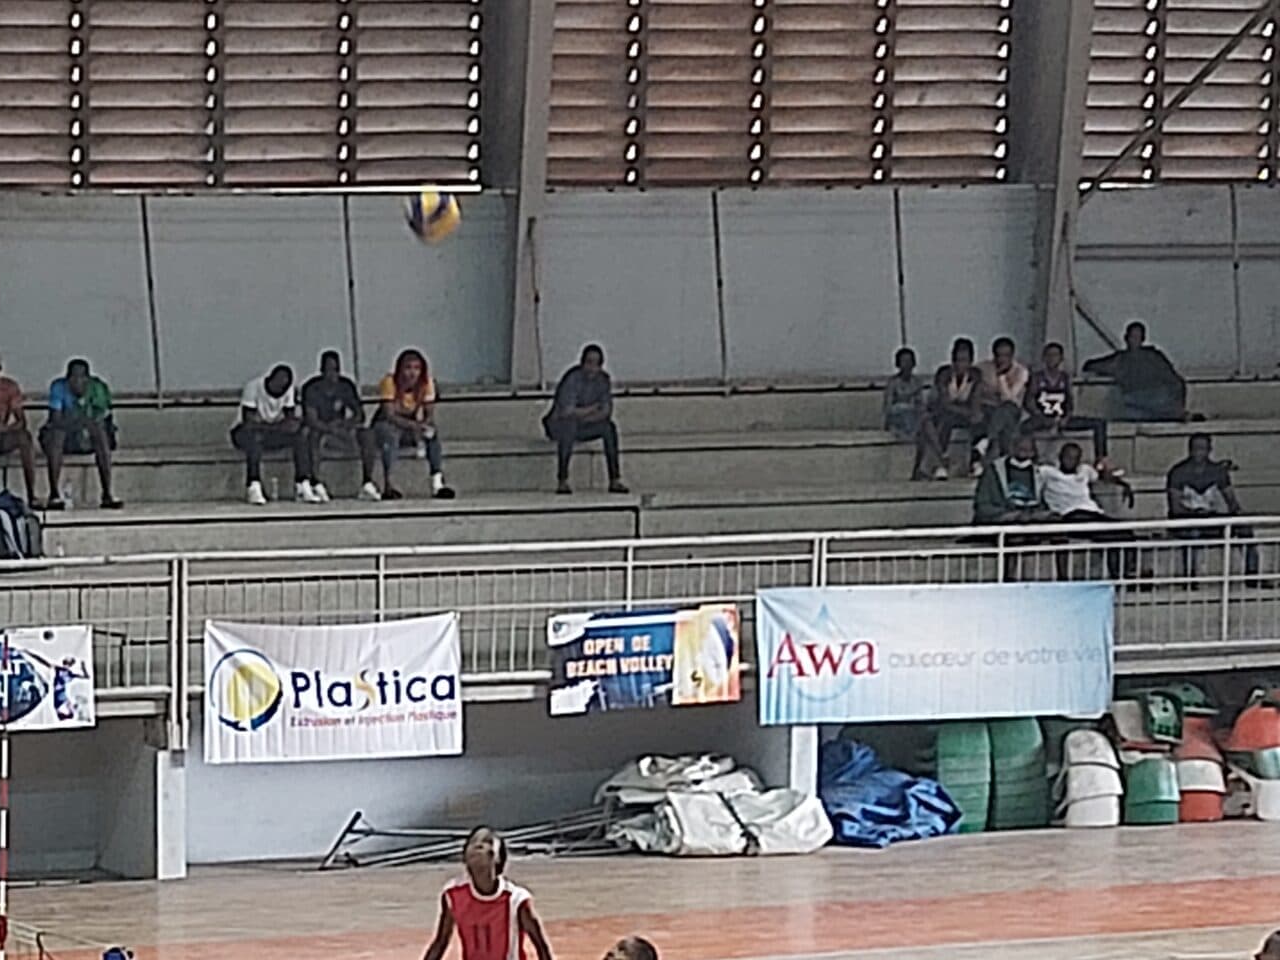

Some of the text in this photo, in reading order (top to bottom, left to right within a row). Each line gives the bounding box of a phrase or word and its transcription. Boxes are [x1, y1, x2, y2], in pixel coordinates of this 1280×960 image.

[583, 635, 652, 655] OPEN DE
[767, 632, 879, 678] Awa
[982, 646, 1009, 667] de
[1015, 646, 1068, 666] votre
[566, 654, 674, 677] BEACH VOLLEY
[290, 668, 456, 710] Plastica
[472, 923, 491, 952] 11
